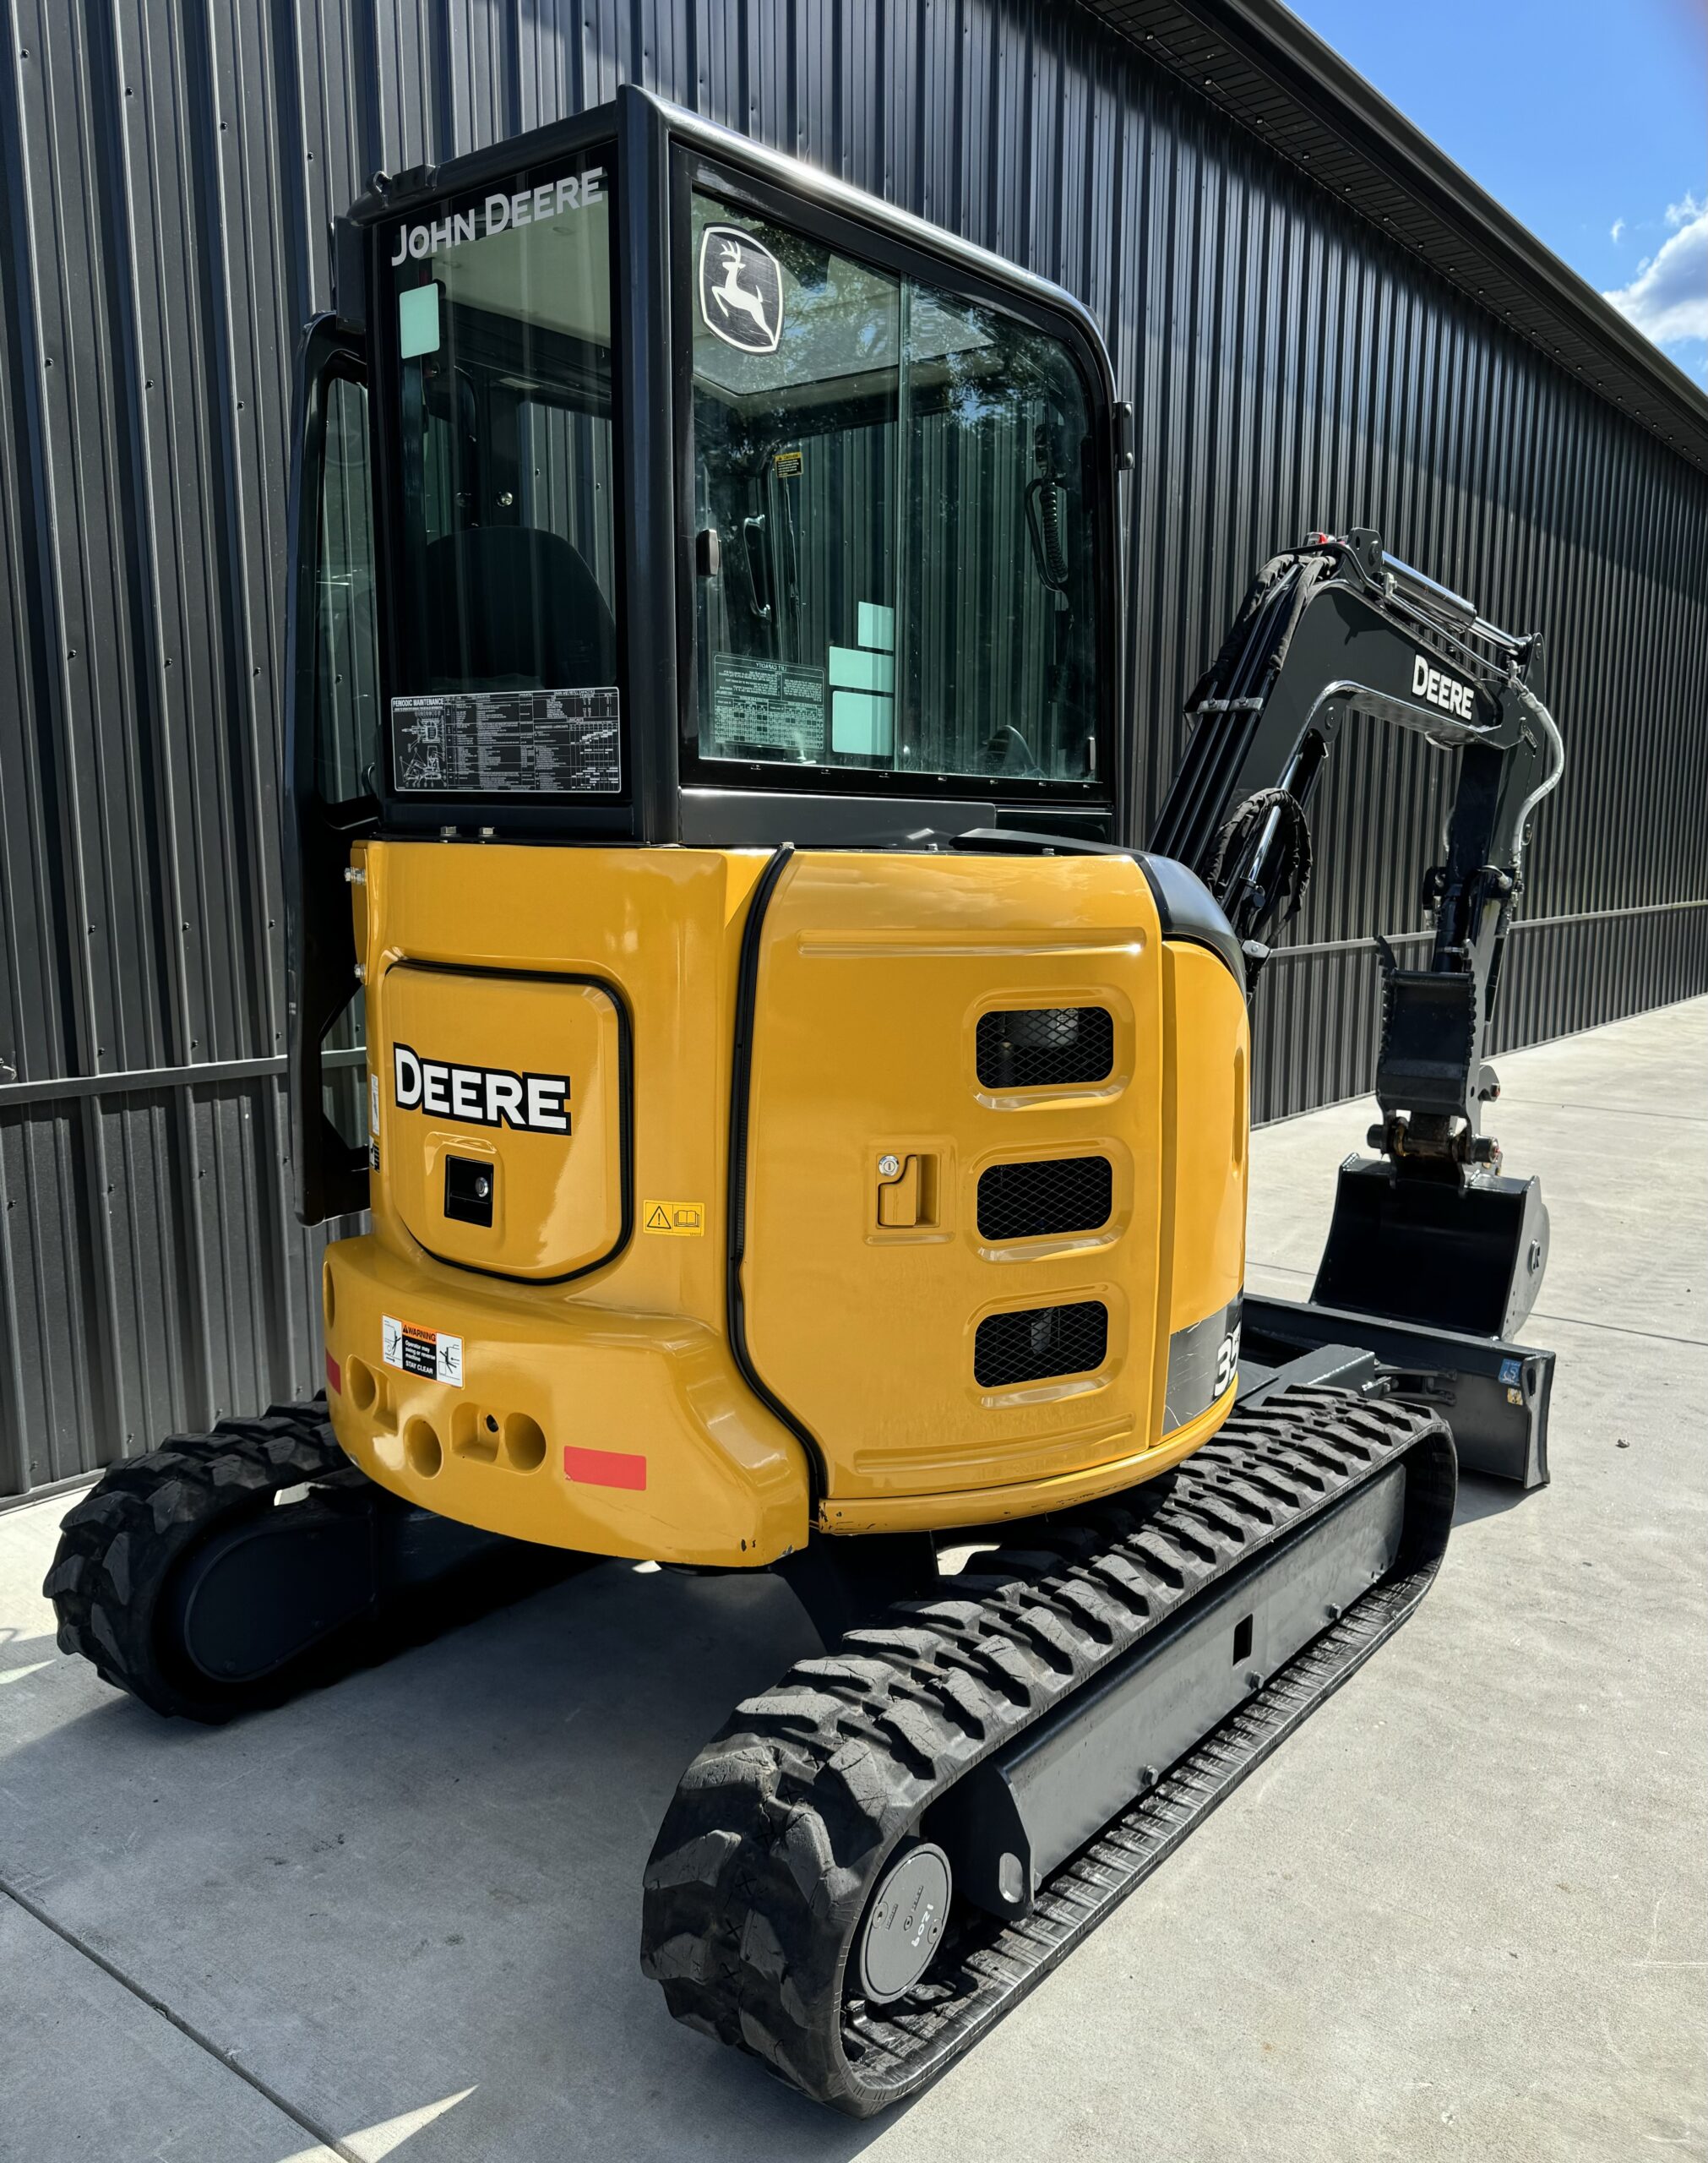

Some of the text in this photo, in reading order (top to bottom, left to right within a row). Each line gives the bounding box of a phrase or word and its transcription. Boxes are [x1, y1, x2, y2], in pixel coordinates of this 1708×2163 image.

[391, 166, 603, 266] JOHN DEERE
[413, 698, 444, 706] MAINTENANCE
[1412, 654, 1475, 721] DEERE
[394, 1048, 567, 1130] DEERE
[407, 1327, 436, 1342] WARNING
[405, 1360, 432, 1374] STAY CLEAR
